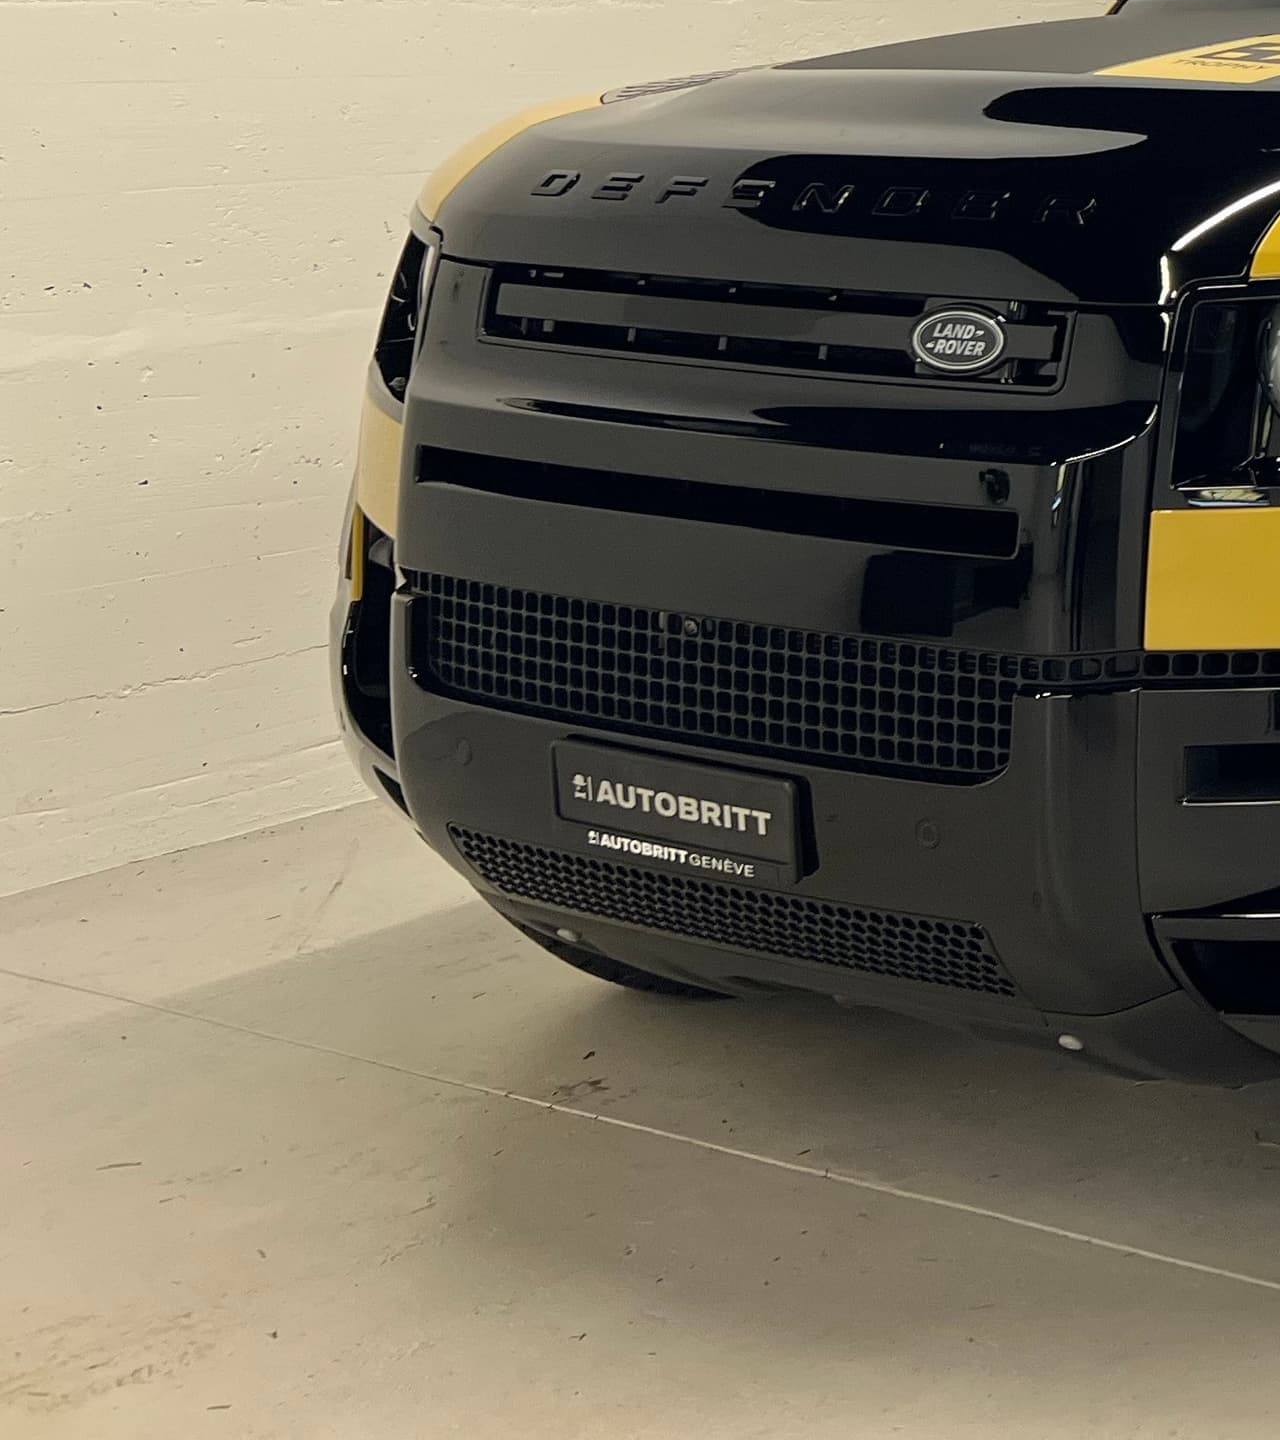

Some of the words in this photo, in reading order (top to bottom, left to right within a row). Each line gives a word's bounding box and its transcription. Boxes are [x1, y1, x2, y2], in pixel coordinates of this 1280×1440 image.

[530, 168, 1098, 226] DEFENDER
[596, 780, 772, 835] AUTOBRITT
[600, 833, 688, 864] AUTOBRITT
[689, 854, 755, 877] GENÈVE
